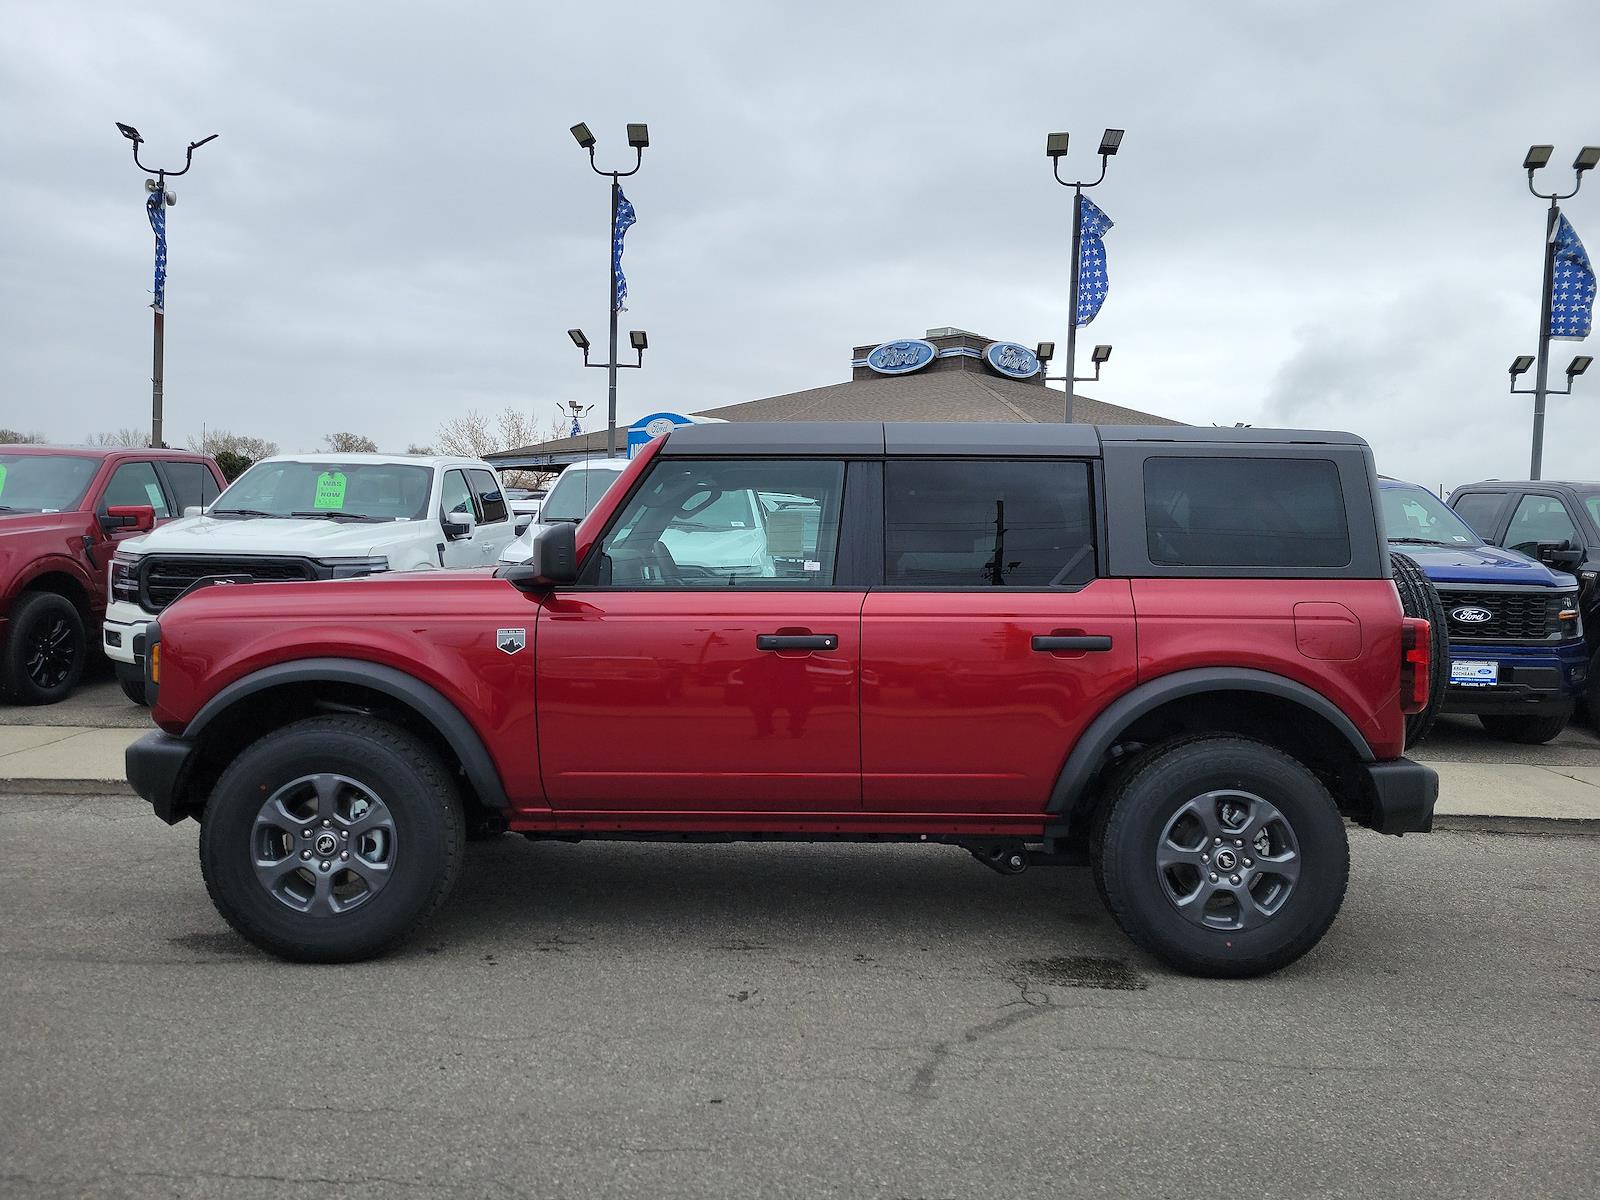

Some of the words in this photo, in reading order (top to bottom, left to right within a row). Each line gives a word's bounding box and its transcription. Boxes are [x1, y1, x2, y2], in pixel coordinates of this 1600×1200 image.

[878, 341, 919, 368] Ford
[997, 344, 1032, 372] Ford
[652, 421, 669, 434] Ford
[1460, 610, 1484, 620] Ford
